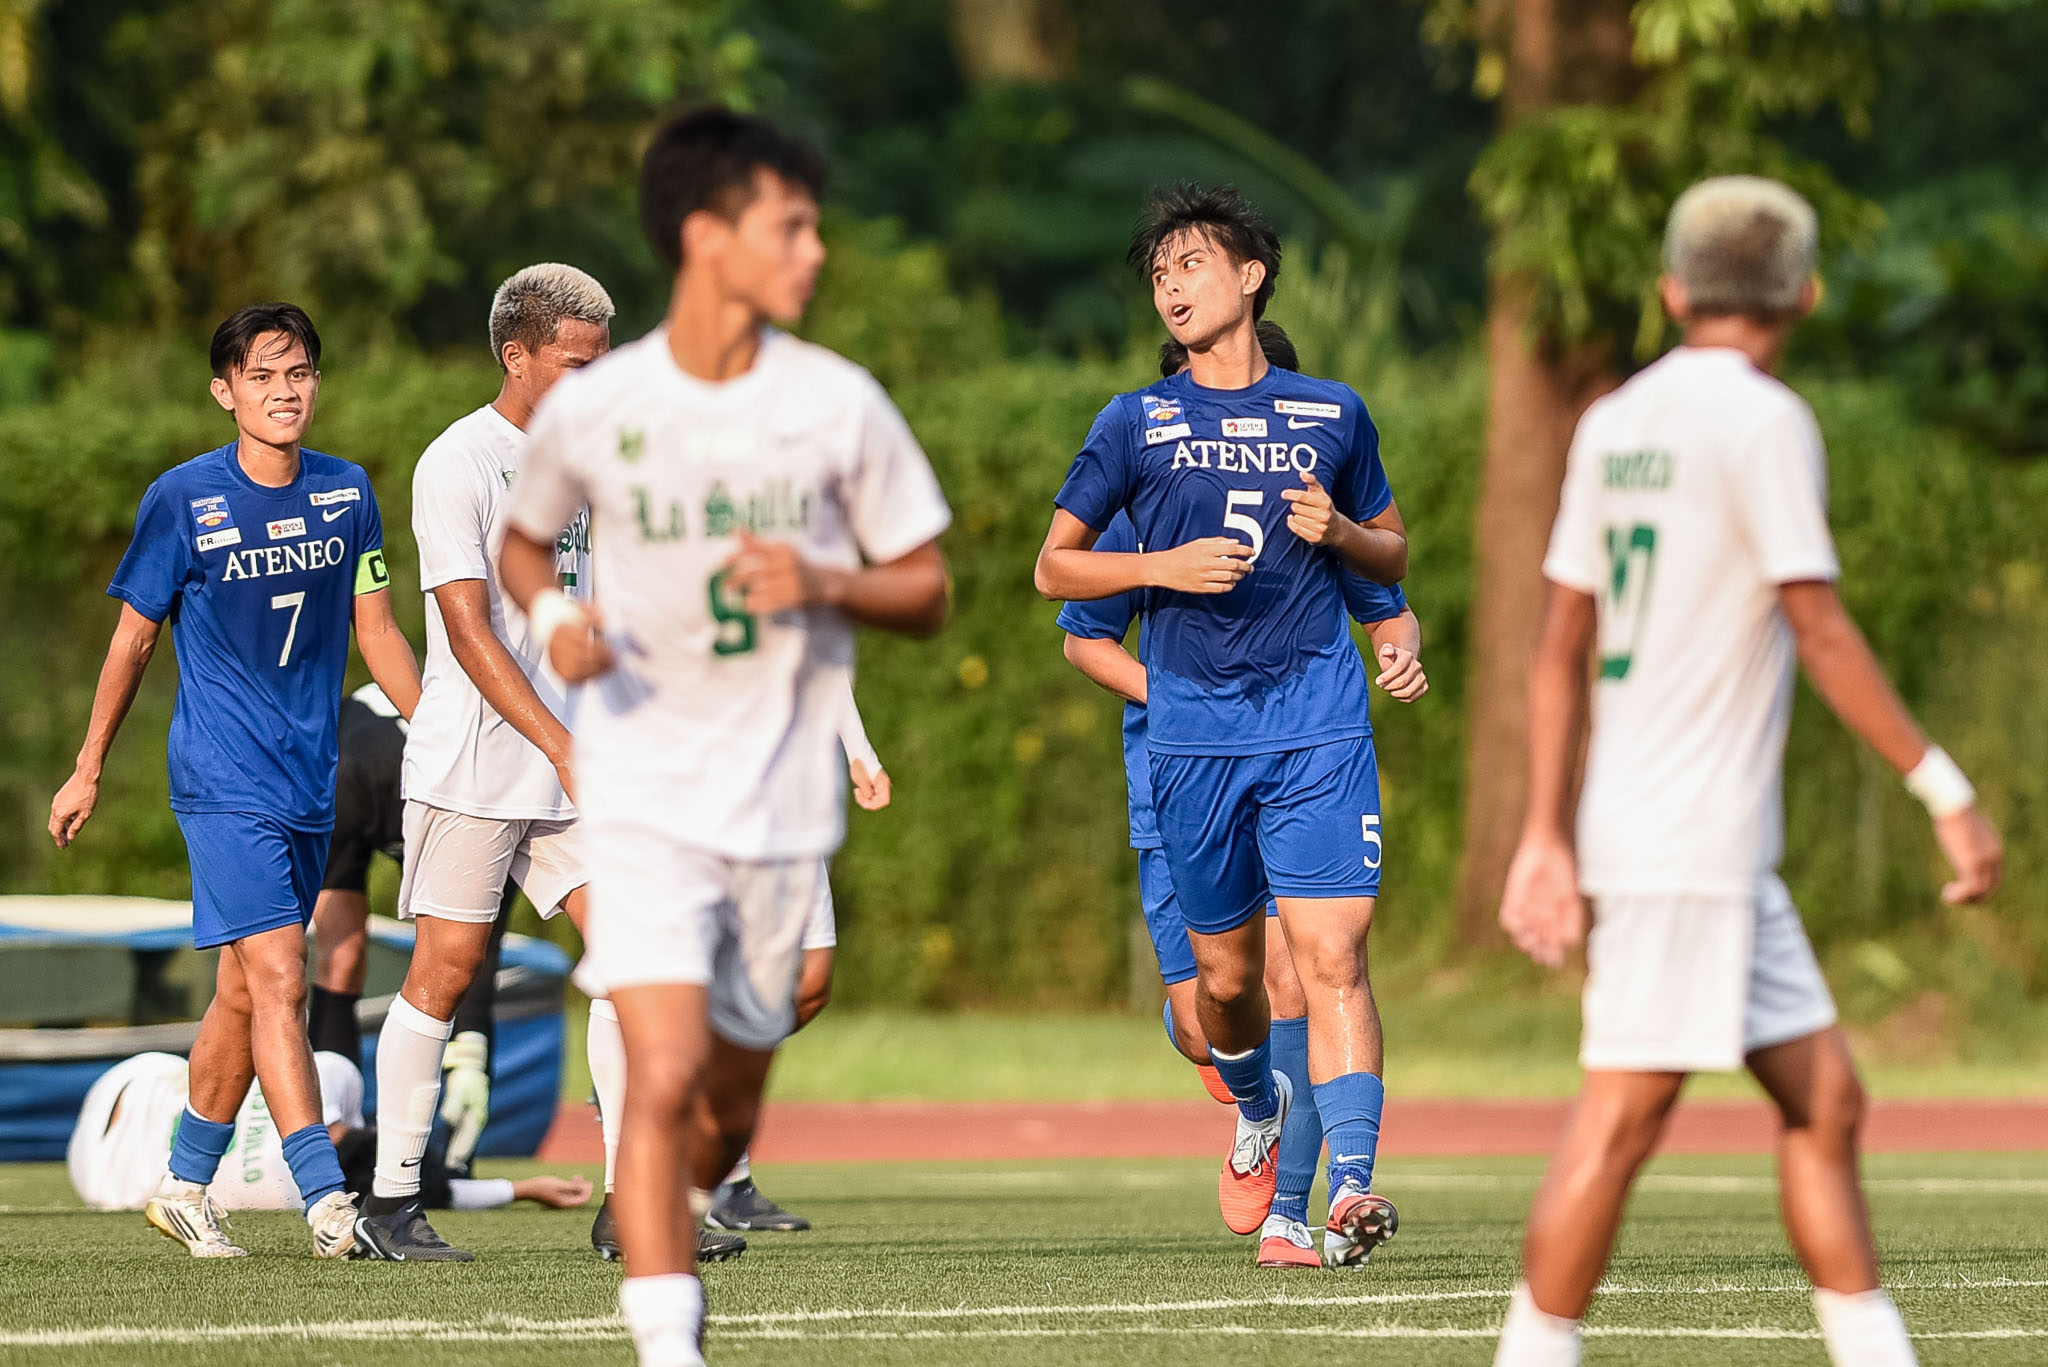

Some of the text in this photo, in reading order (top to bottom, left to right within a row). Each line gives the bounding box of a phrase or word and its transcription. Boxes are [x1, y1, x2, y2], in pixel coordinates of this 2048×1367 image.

[1170, 440, 1318, 474] ATENEO
[1223, 490, 1264, 566] 5
[221, 536, 345, 582] ATENEO
[368, 554, 388, 584] C
[271, 591, 306, 668] 7
[1361, 814, 1382, 869] 5
